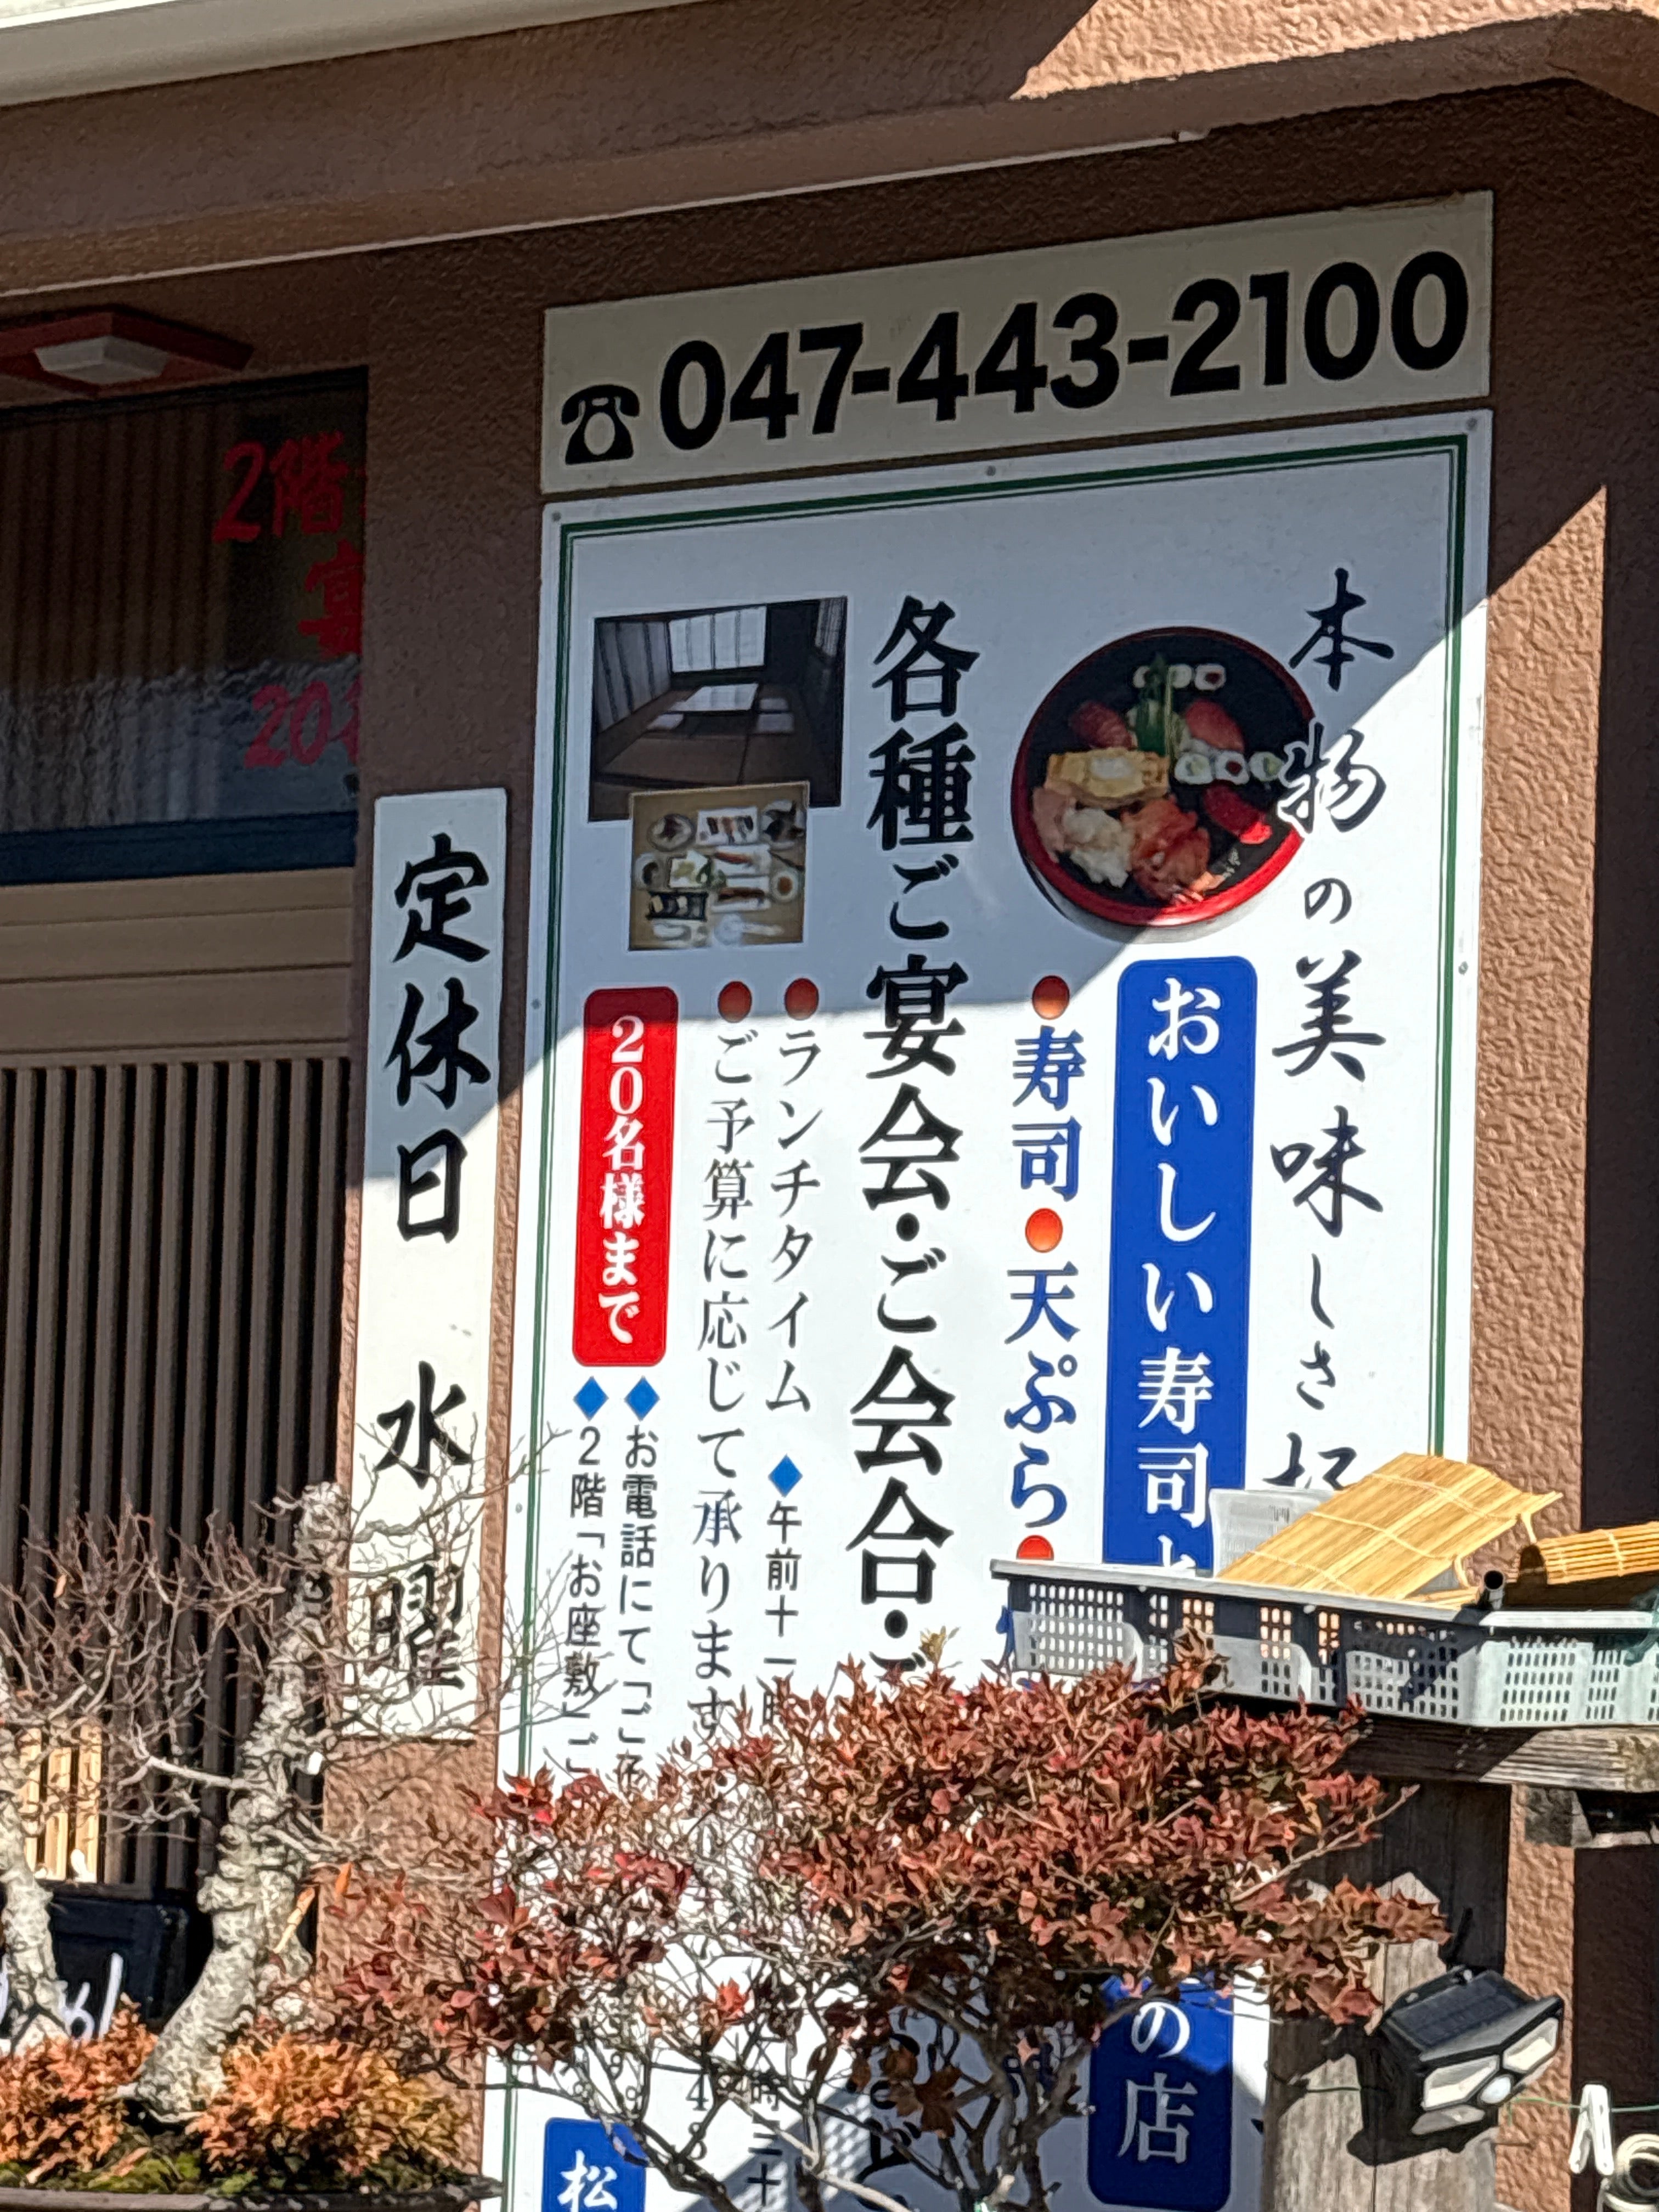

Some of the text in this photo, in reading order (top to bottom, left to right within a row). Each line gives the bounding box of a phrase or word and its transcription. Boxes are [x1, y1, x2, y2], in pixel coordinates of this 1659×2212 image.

[659, 251, 1469, 450] 047-443-2100
[383, 832, 492, 1243] 定休日
[598, 1014, 646, 1345] 20名様まで
[765, 1029, 822, 1413] ランチタイム
[1004, 1025, 1087, 1528] 寿司 天ぷら
[557, 2149, 618, 2212] 松
